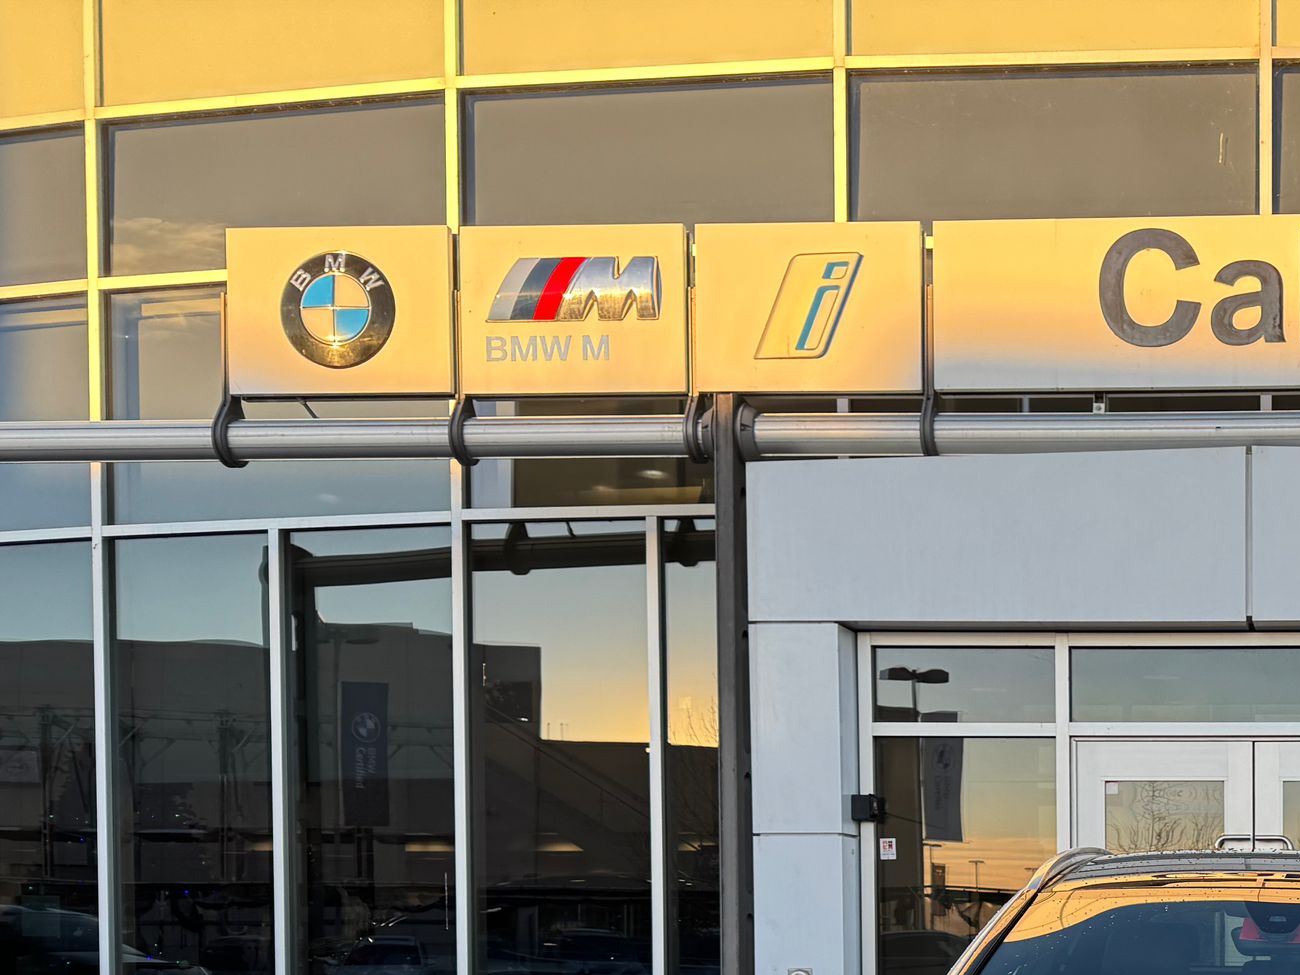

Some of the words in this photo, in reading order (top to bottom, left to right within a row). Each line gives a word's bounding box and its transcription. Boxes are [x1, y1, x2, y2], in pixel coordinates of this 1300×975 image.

[291, 251, 383, 293] BMW
[486, 334, 572, 364] BMW
[583, 333, 611, 362] M
